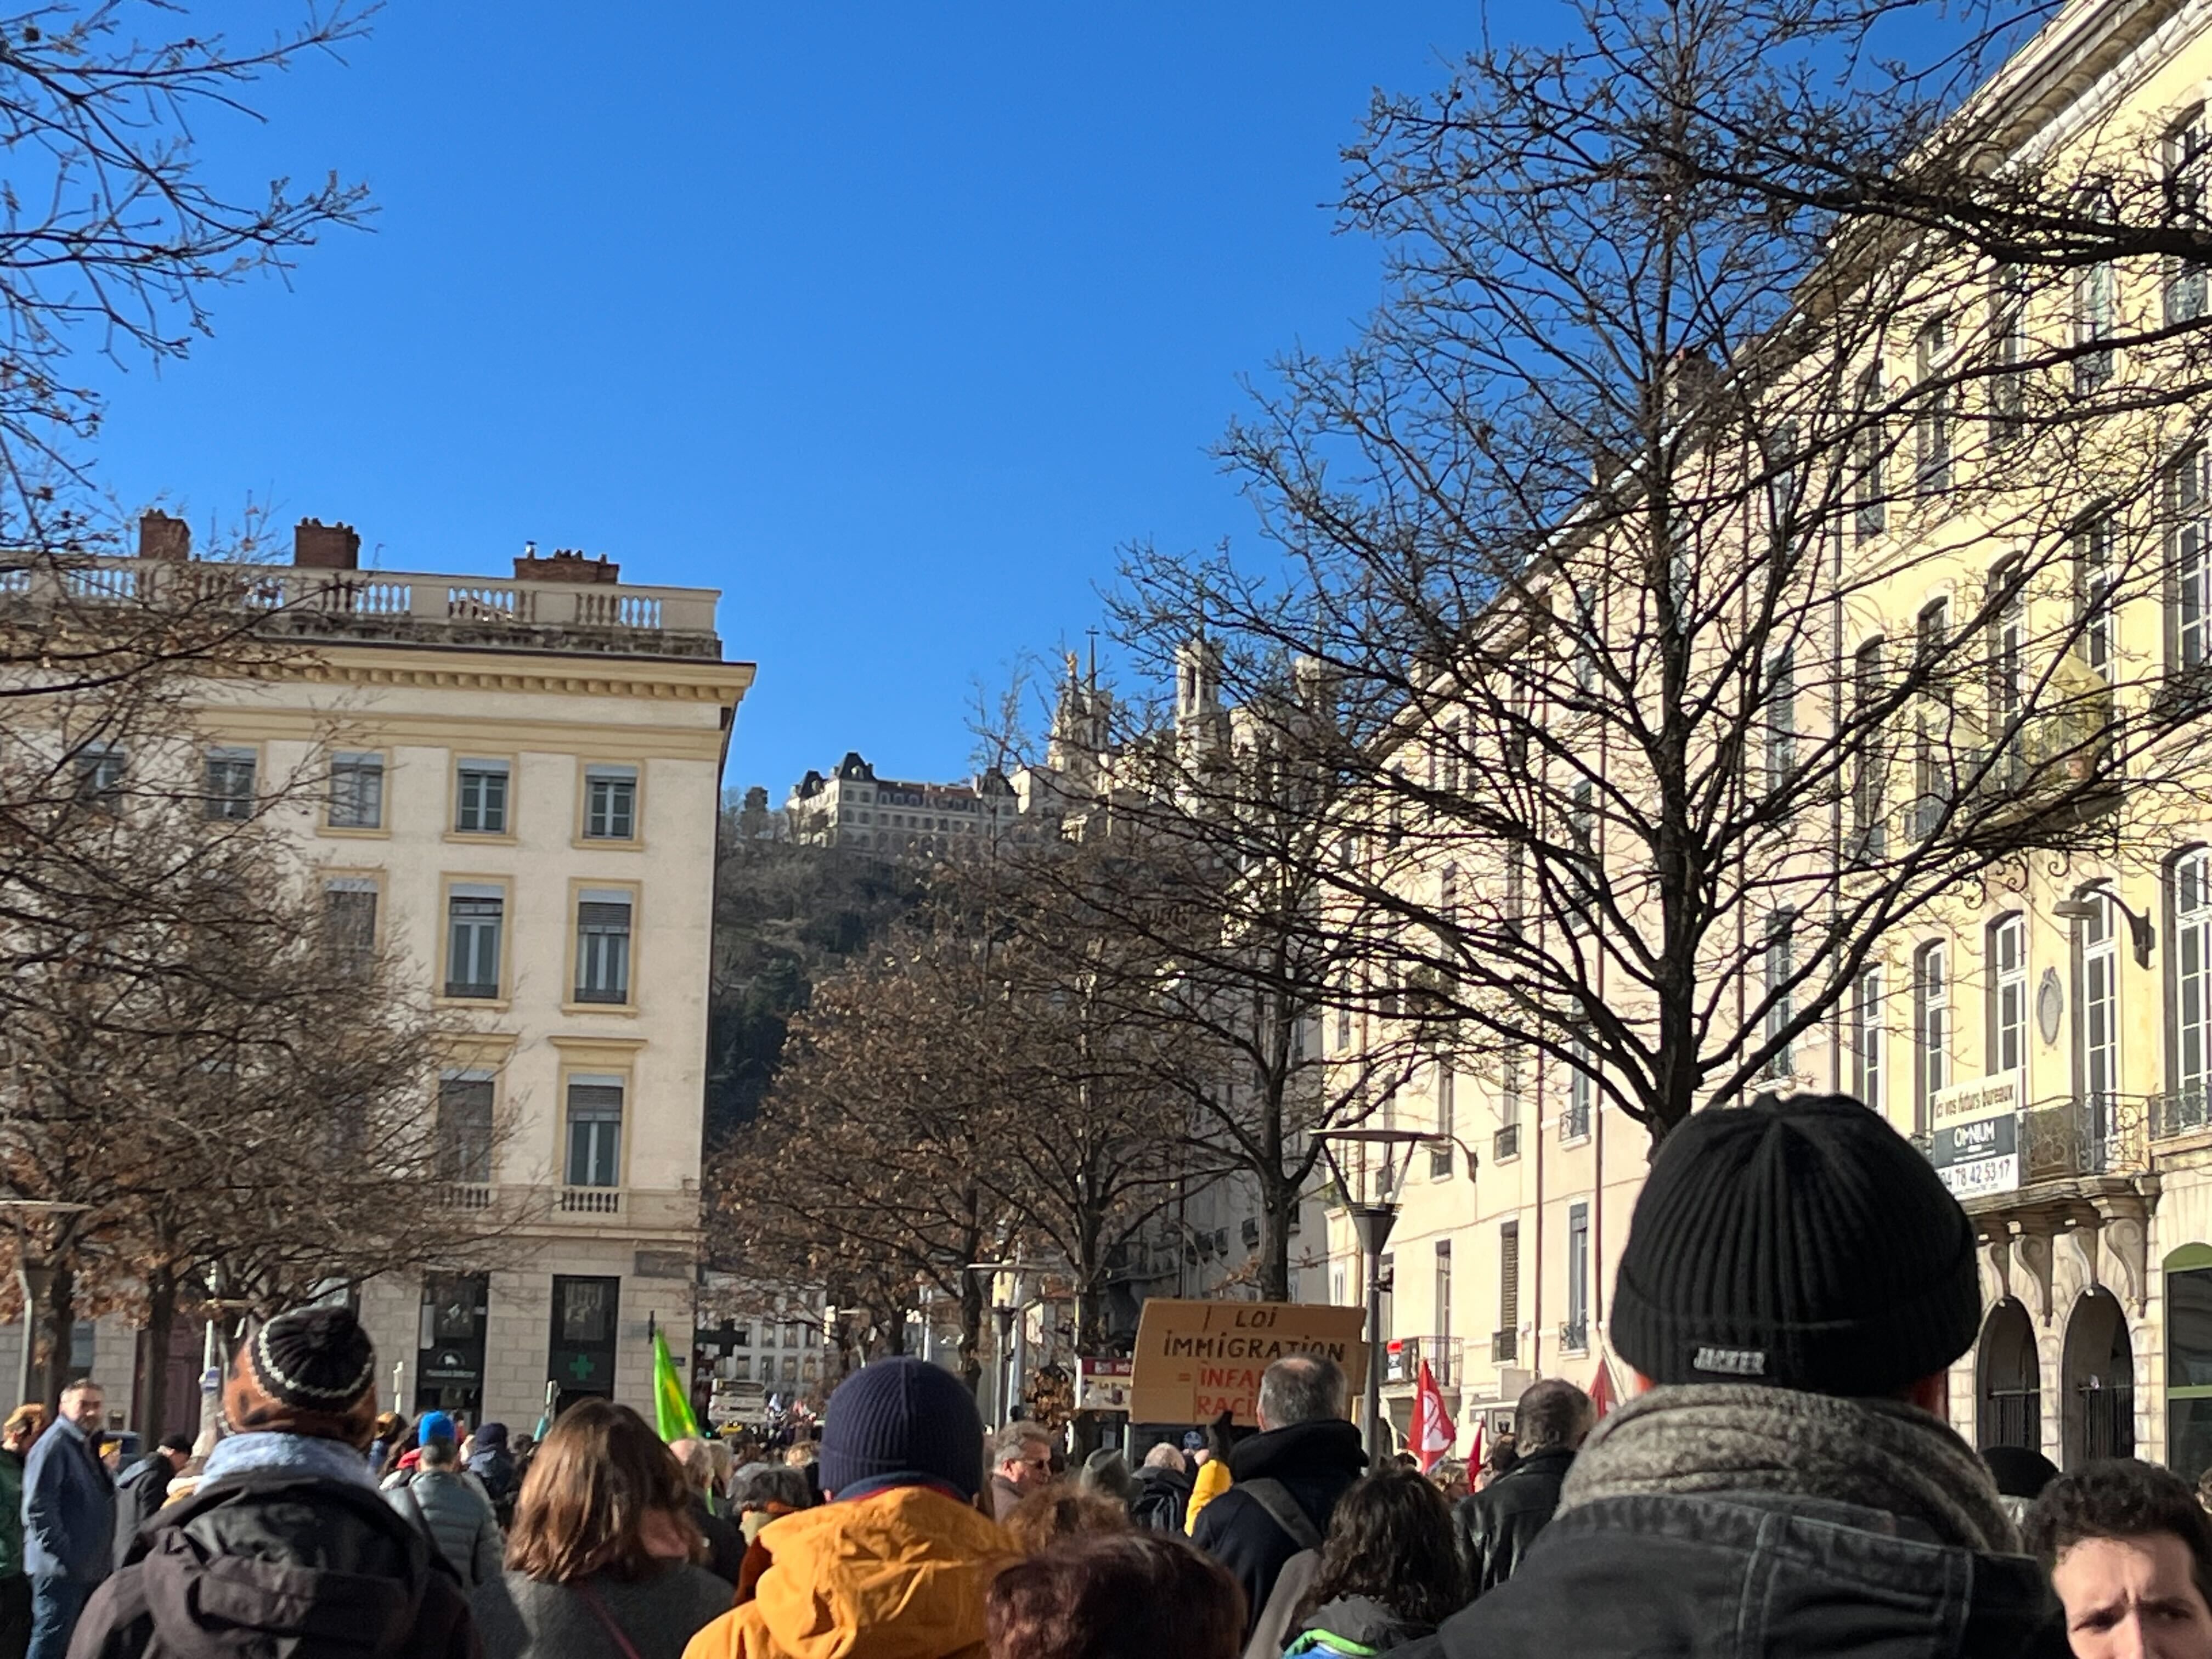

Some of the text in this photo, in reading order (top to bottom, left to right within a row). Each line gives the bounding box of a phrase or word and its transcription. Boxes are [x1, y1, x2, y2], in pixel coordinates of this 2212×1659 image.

[1955, 1167, 1967, 1187] 78
[1970, 1164, 1982, 1184] 42
[1984, 1161, 1996, 1182] 53
